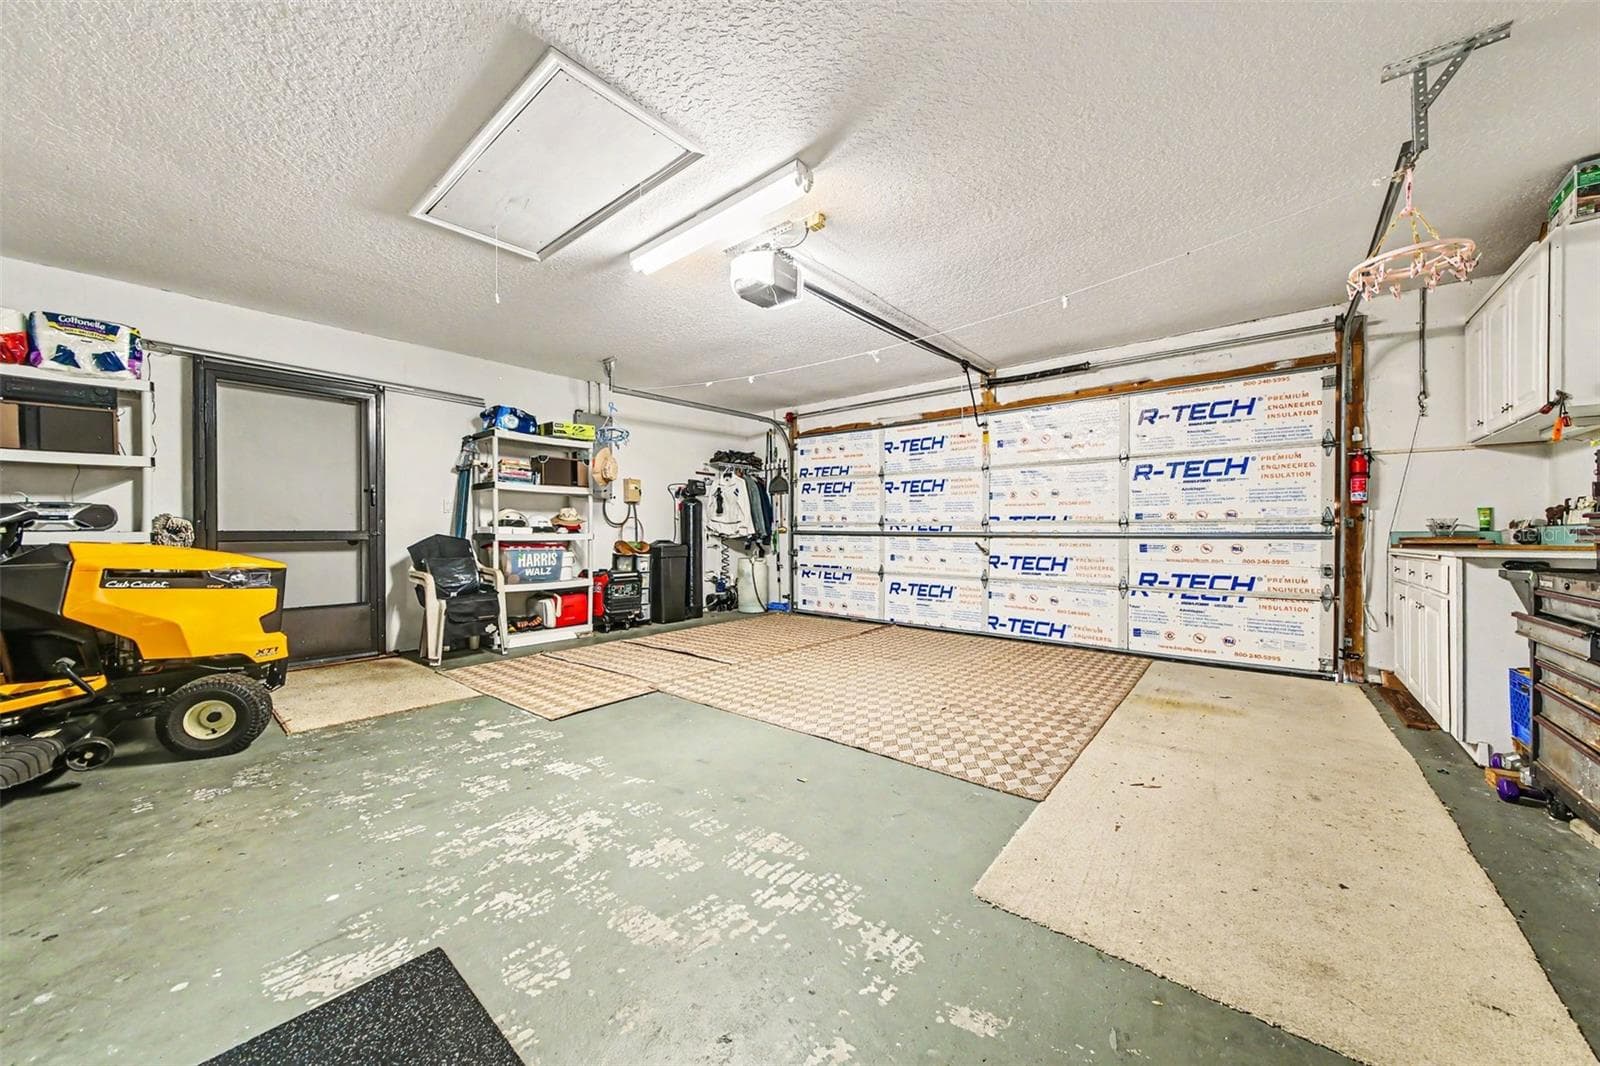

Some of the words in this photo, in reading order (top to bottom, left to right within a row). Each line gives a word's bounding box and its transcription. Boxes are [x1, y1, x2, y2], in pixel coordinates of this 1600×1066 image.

[57, 314, 106, 330] Cottonelle
[1267, 392, 1310, 401] PREMIUM
[1138, 396, 1257, 426] R-TECH
[1267, 401, 1323, 411] ENGINEERED
[1267, 410, 1319, 419] INSULATION
[884, 435, 946, 454] R-TECH
[1260, 453, 1302, 461] PREMIUM
[799, 465, 850, 478] R-TECH
[1132, 456, 1250, 481] R-TECH
[1260, 463, 1316, 471] ENGINEERED
[1260, 472, 1312, 480] INSULATION
[801, 481, 853, 495] R-TECH
[884, 478, 946, 495] R-TECH
[517, 551, 558, 568] HARRIS
[988, 555, 1069, 572] R-TECH
[524, 566, 552, 577] WALZ
[105, 581, 129, 589] Cub
[131, 581, 169, 589] Cadet
[1138, 572, 1257, 592] R-TECH
[1267, 577, 1309, 585] PREMIUM
[889, 581, 954, 599] R-TECH
[1258, 604, 1310, 613] INSULATION
[987, 615, 1068, 639] R-TECH
[255, 646, 279, 655] XT1
